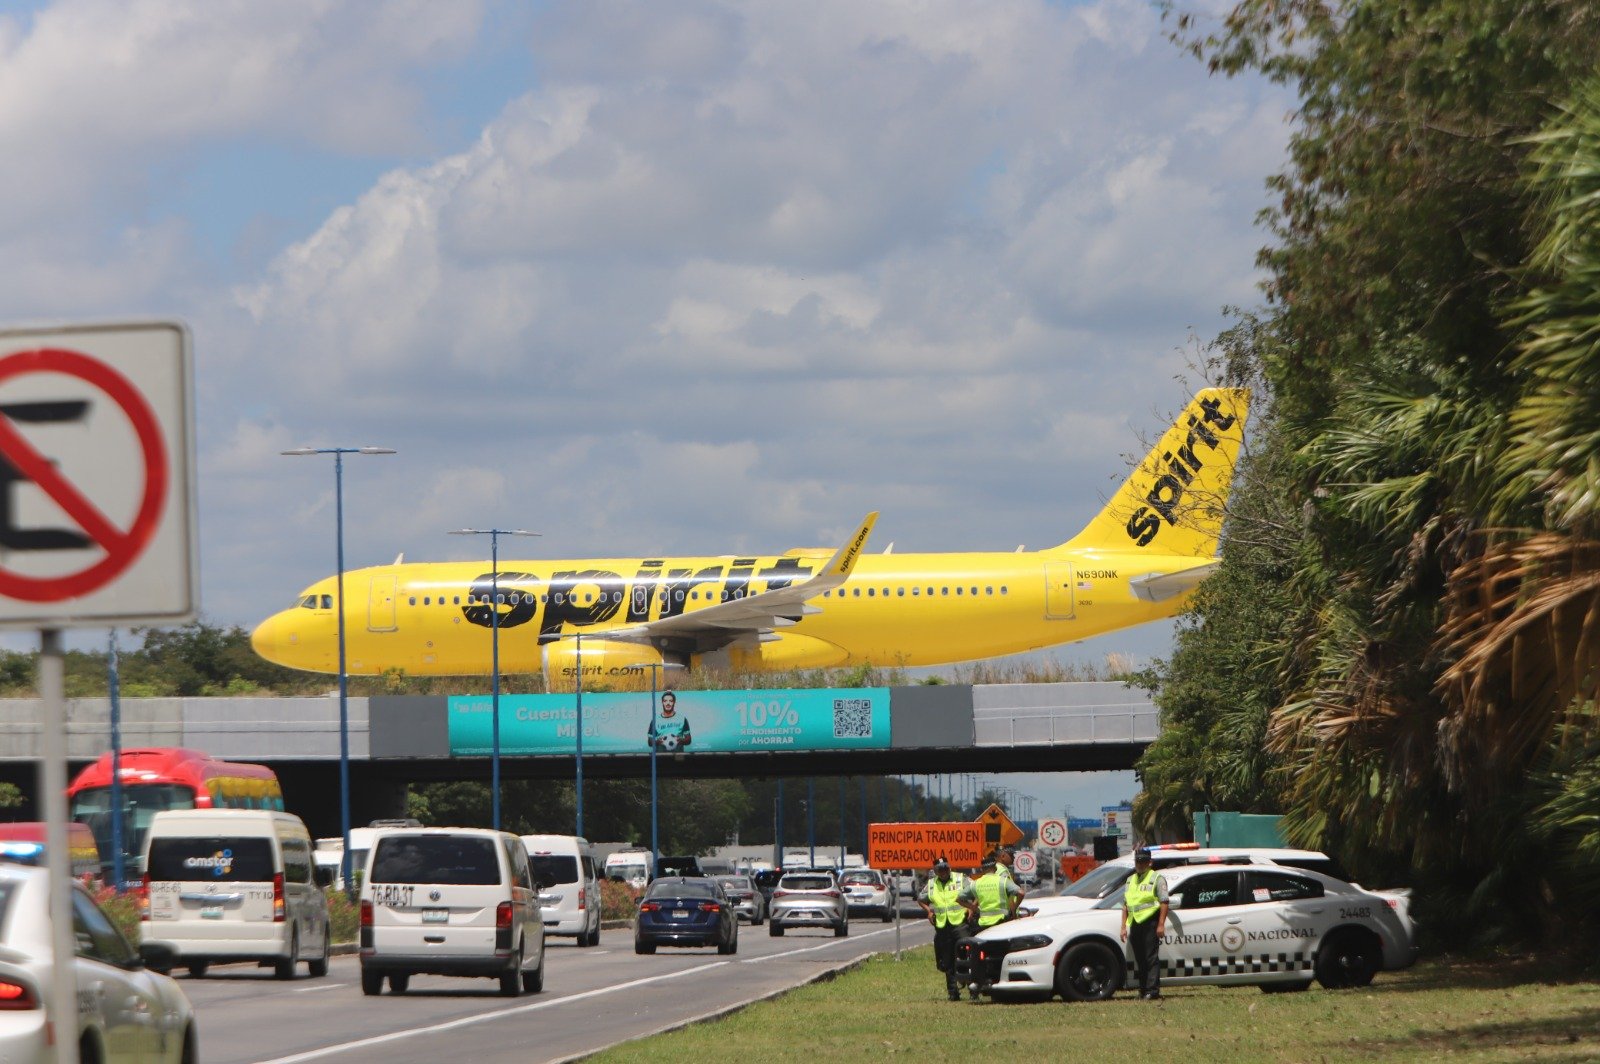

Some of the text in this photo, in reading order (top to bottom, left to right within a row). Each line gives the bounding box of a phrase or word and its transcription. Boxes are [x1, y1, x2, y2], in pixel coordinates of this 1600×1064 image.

[1126, 397, 1235, 547] spirit
[840, 527, 869, 572] spirit.com
[1076, 570, 1118, 579] N690NK
[461, 558, 813, 646] spirit
[516, 706, 576, 721] Cuenta
[736, 701, 800, 727] 10%
[557, 723, 600, 738] Miel
[741, 727, 802, 736] RENDIMIENTO
[739, 736, 794, 747] por AHORRAR
[872, 830, 979, 844] PRINCIPIA TRAMO EN
[187, 857, 233, 867] amstar
[874, 849, 978, 862] REPARACION A 1000m
[1247, 927, 1317, 941] NACIONAL
